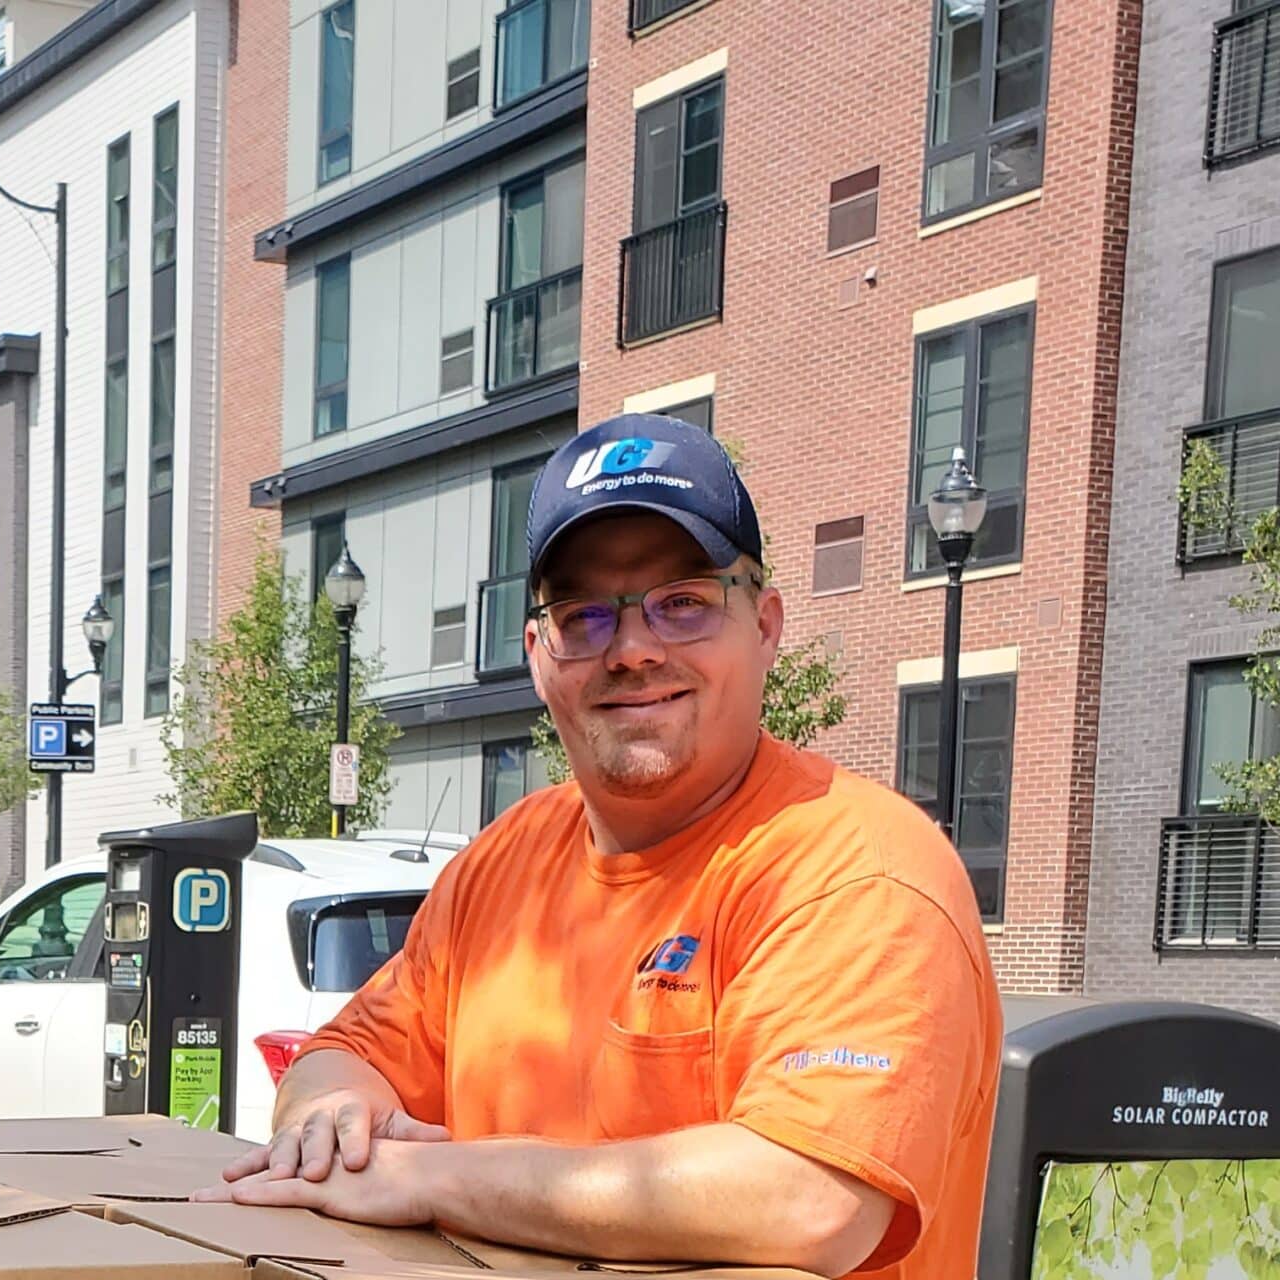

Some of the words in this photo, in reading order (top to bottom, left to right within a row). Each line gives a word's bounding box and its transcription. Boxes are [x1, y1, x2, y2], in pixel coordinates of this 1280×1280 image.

[582, 478, 621, 495] Energy
[623, 475, 636, 486] to
[637, 471, 654, 484] do
[39, 725, 58, 750] P
[190, 879, 219, 922] P
[177, 1030, 218, 1044] 85135
[1112, 1107, 1165, 1124] SOLAR
[1172, 1109, 1269, 1127] COMPACTOR
